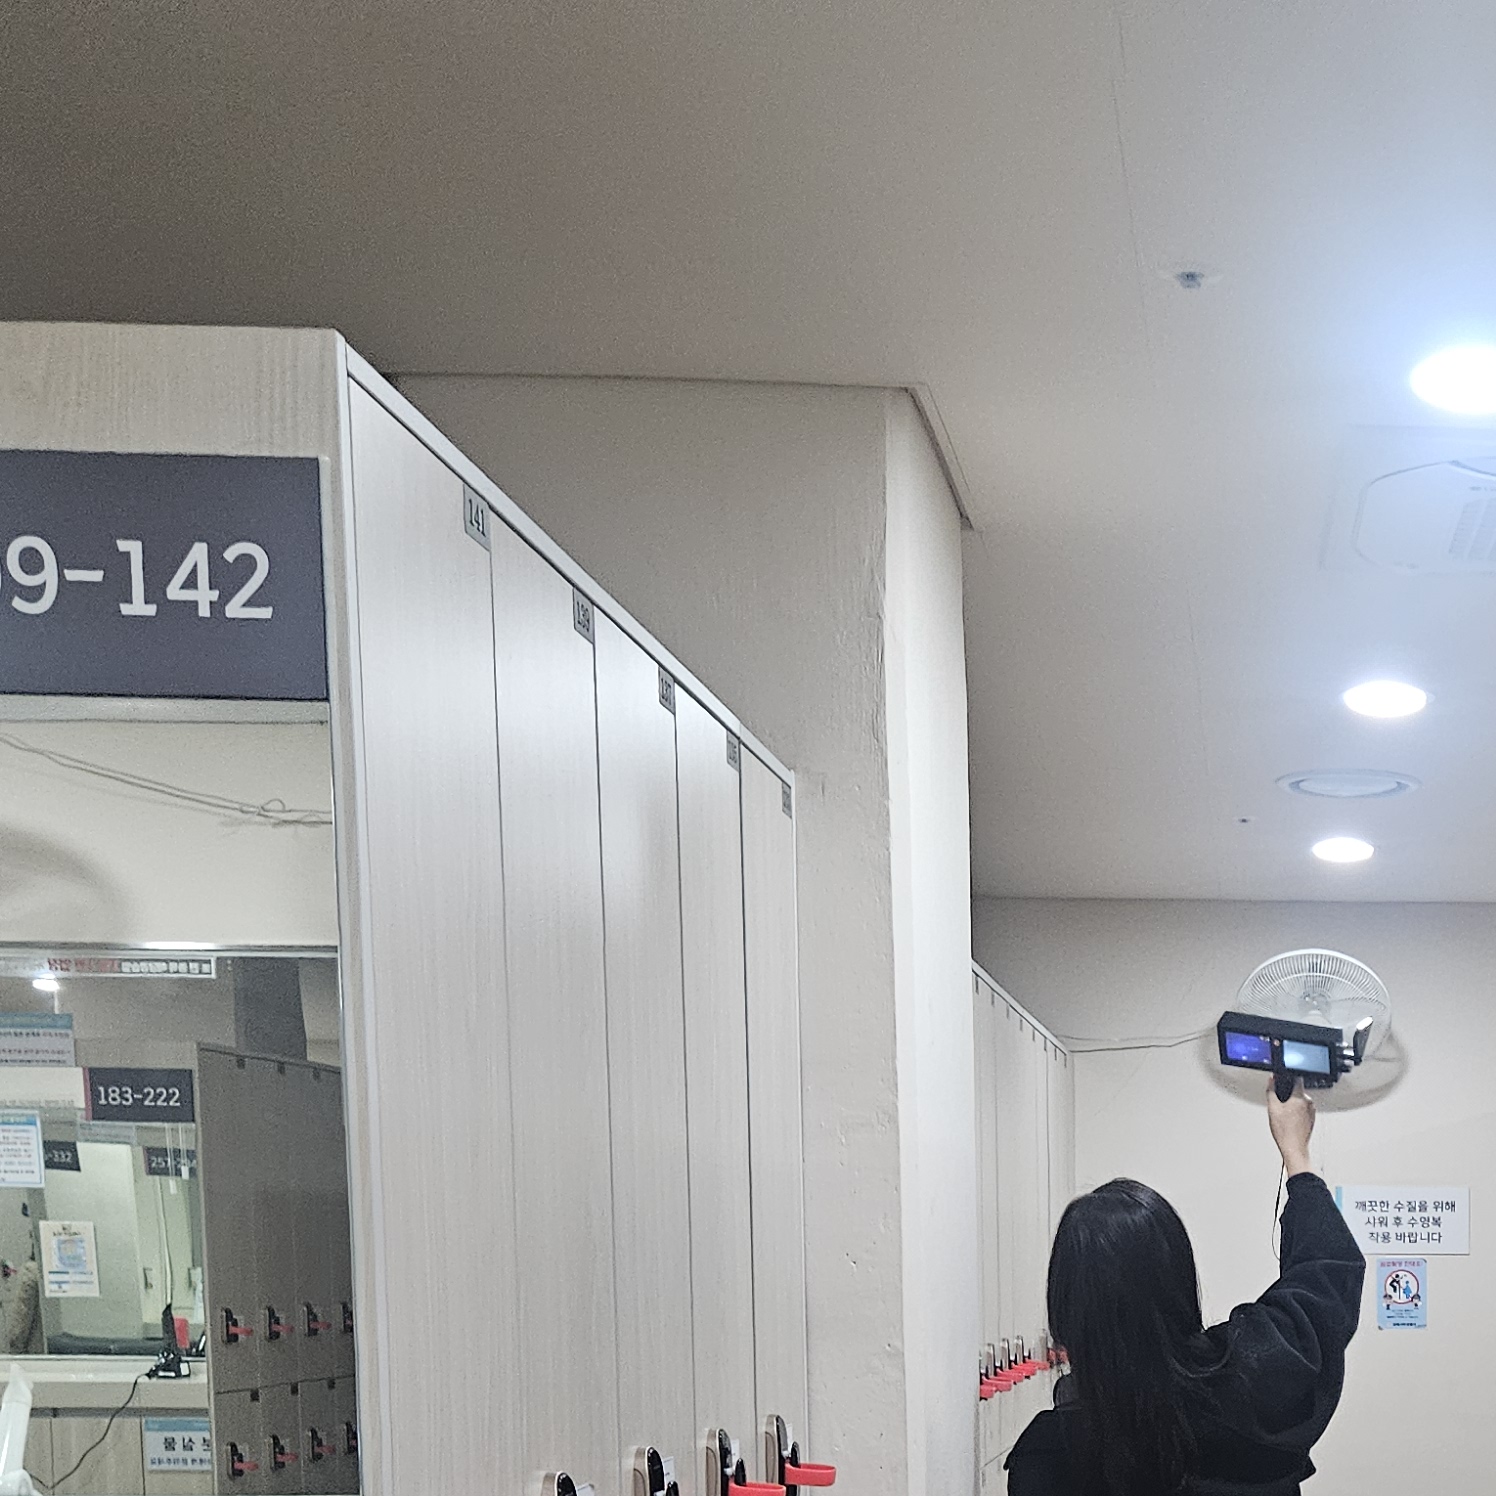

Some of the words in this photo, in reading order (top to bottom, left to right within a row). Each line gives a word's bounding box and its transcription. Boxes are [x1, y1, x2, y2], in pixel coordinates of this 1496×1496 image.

[468, 498, 487, 538] 141
[0, 535, 273, 619] 9-142
[97, 1086, 181, 1107] 183-222
[1354, 1200, 1390, 1213] 깨끗한
[1393, 1200, 1428, 1213] 수질을
[1432, 1200, 1456, 1213] 위해
[1391, 1215, 1404, 1228] 후
[1407, 1215, 1442, 1229] 수영복
[1395, 1231, 1442, 1244] 바랍니다
